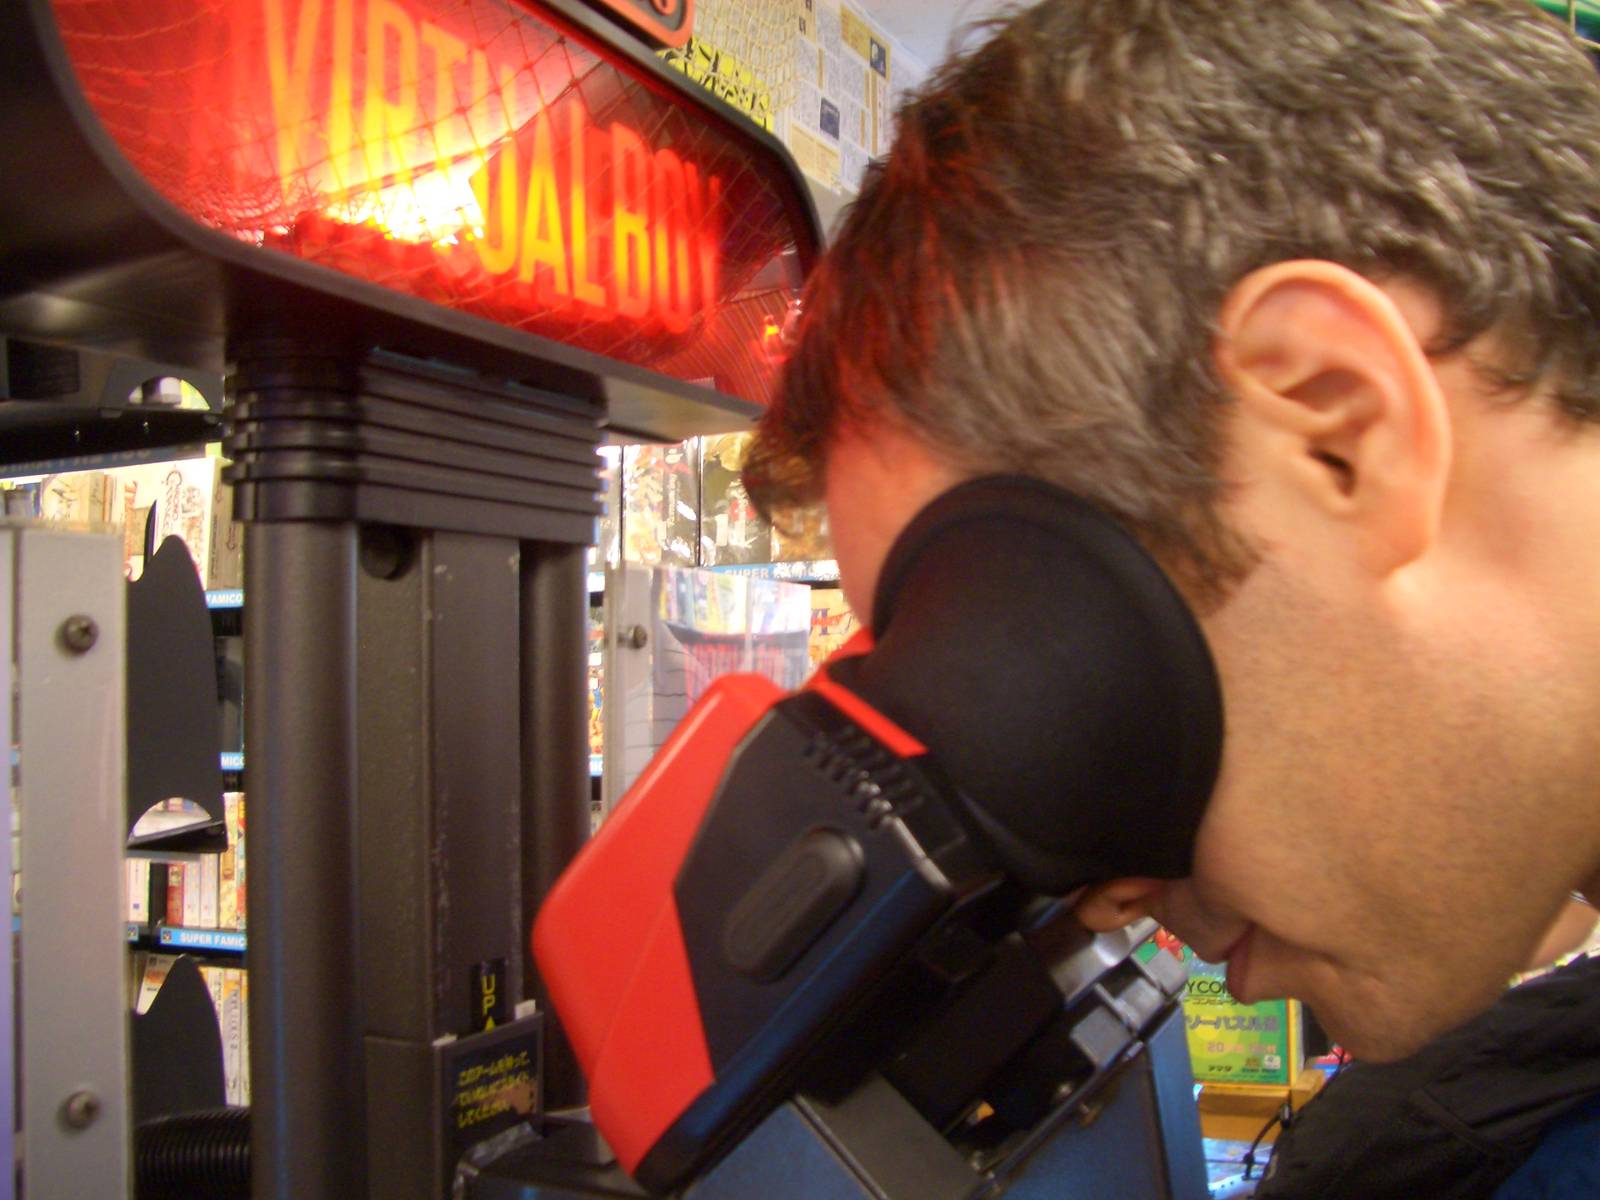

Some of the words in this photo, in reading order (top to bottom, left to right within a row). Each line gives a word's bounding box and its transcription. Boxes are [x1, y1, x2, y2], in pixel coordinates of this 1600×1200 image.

[264, 0, 607, 307] VIRTUAL
[180, 931, 212, 945] SUPER
[482, 974, 496, 1015] UP
